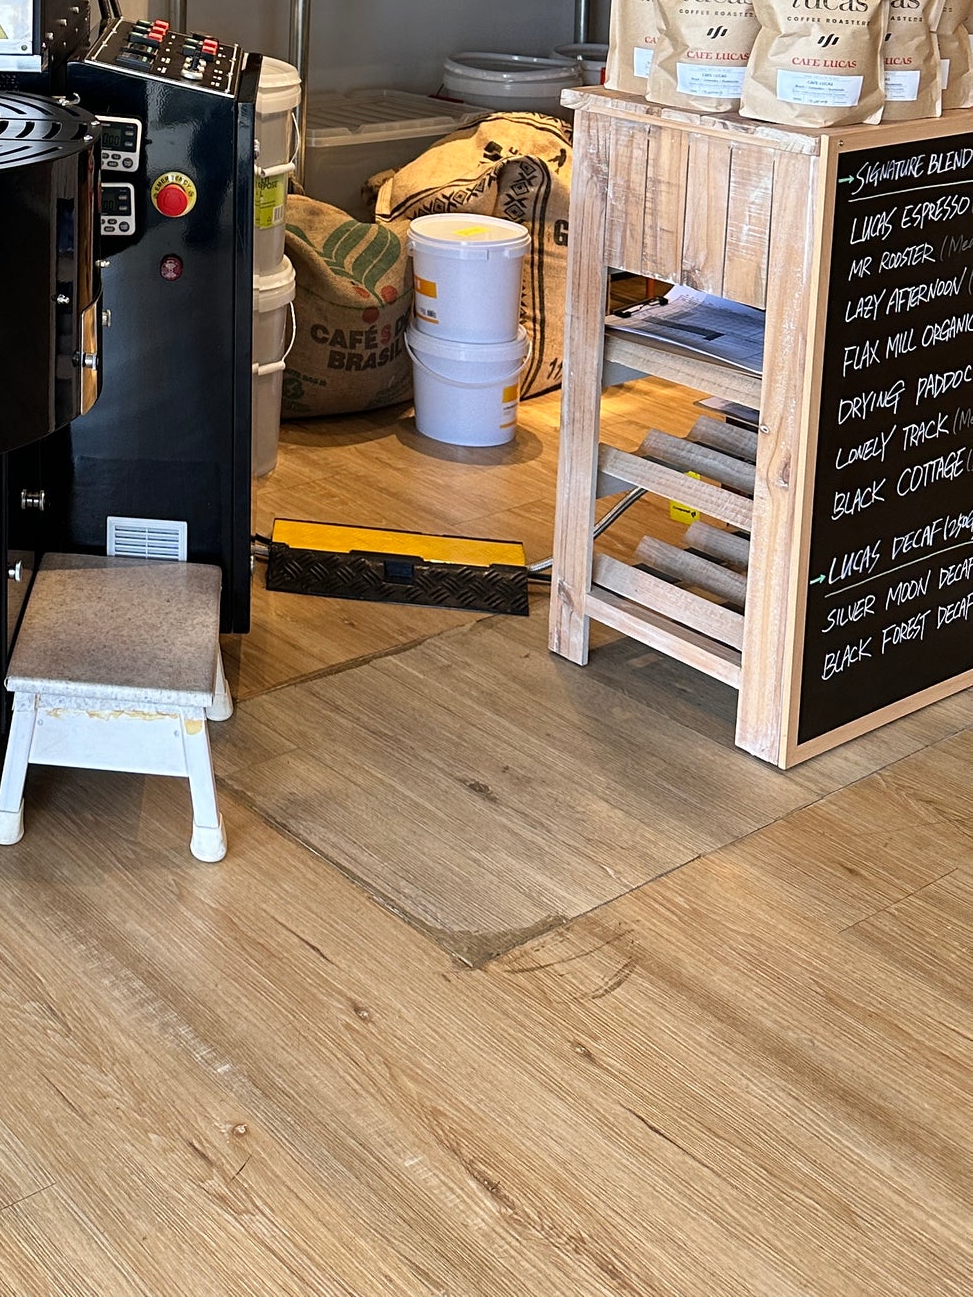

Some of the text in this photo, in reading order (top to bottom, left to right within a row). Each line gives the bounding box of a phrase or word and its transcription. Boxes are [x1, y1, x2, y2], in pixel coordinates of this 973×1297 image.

[679, 8, 756, 19] COFFEE ROASTER
[787, 15, 822, 23] COFFEE
[686, 50, 750, 61] CAFE LUCAS
[792, 56, 857, 69] CAFE LUCAS
[883, 56, 912, 66] UCAS
[851, 154, 924, 195] SIGNATURE
[850, 196, 971, 245] LUCAS ESPRESSO
[848, 258, 871, 282] MR
[878, 243, 935, 277] ROOSTER
[845, 267, 964, 323] LAZY AFTERNOON
[327, 339, 402, 372] BRASIL
[842, 339, 879, 378] FLAX
[886, 328, 917, 362] MILL
[837, 365, 973, 425] DRYING PADDOC
[835, 425, 897, 470] LONELY
[902, 412, 950, 452] TRACK
[831, 447, 964, 521] BLACK COTTAGE
[828, 541, 881, 585] LUCAS
[822, 558, 973, 633] SILVER MOON DECAF
[821, 591, 973, 681] BLACK FOREST DECAF
